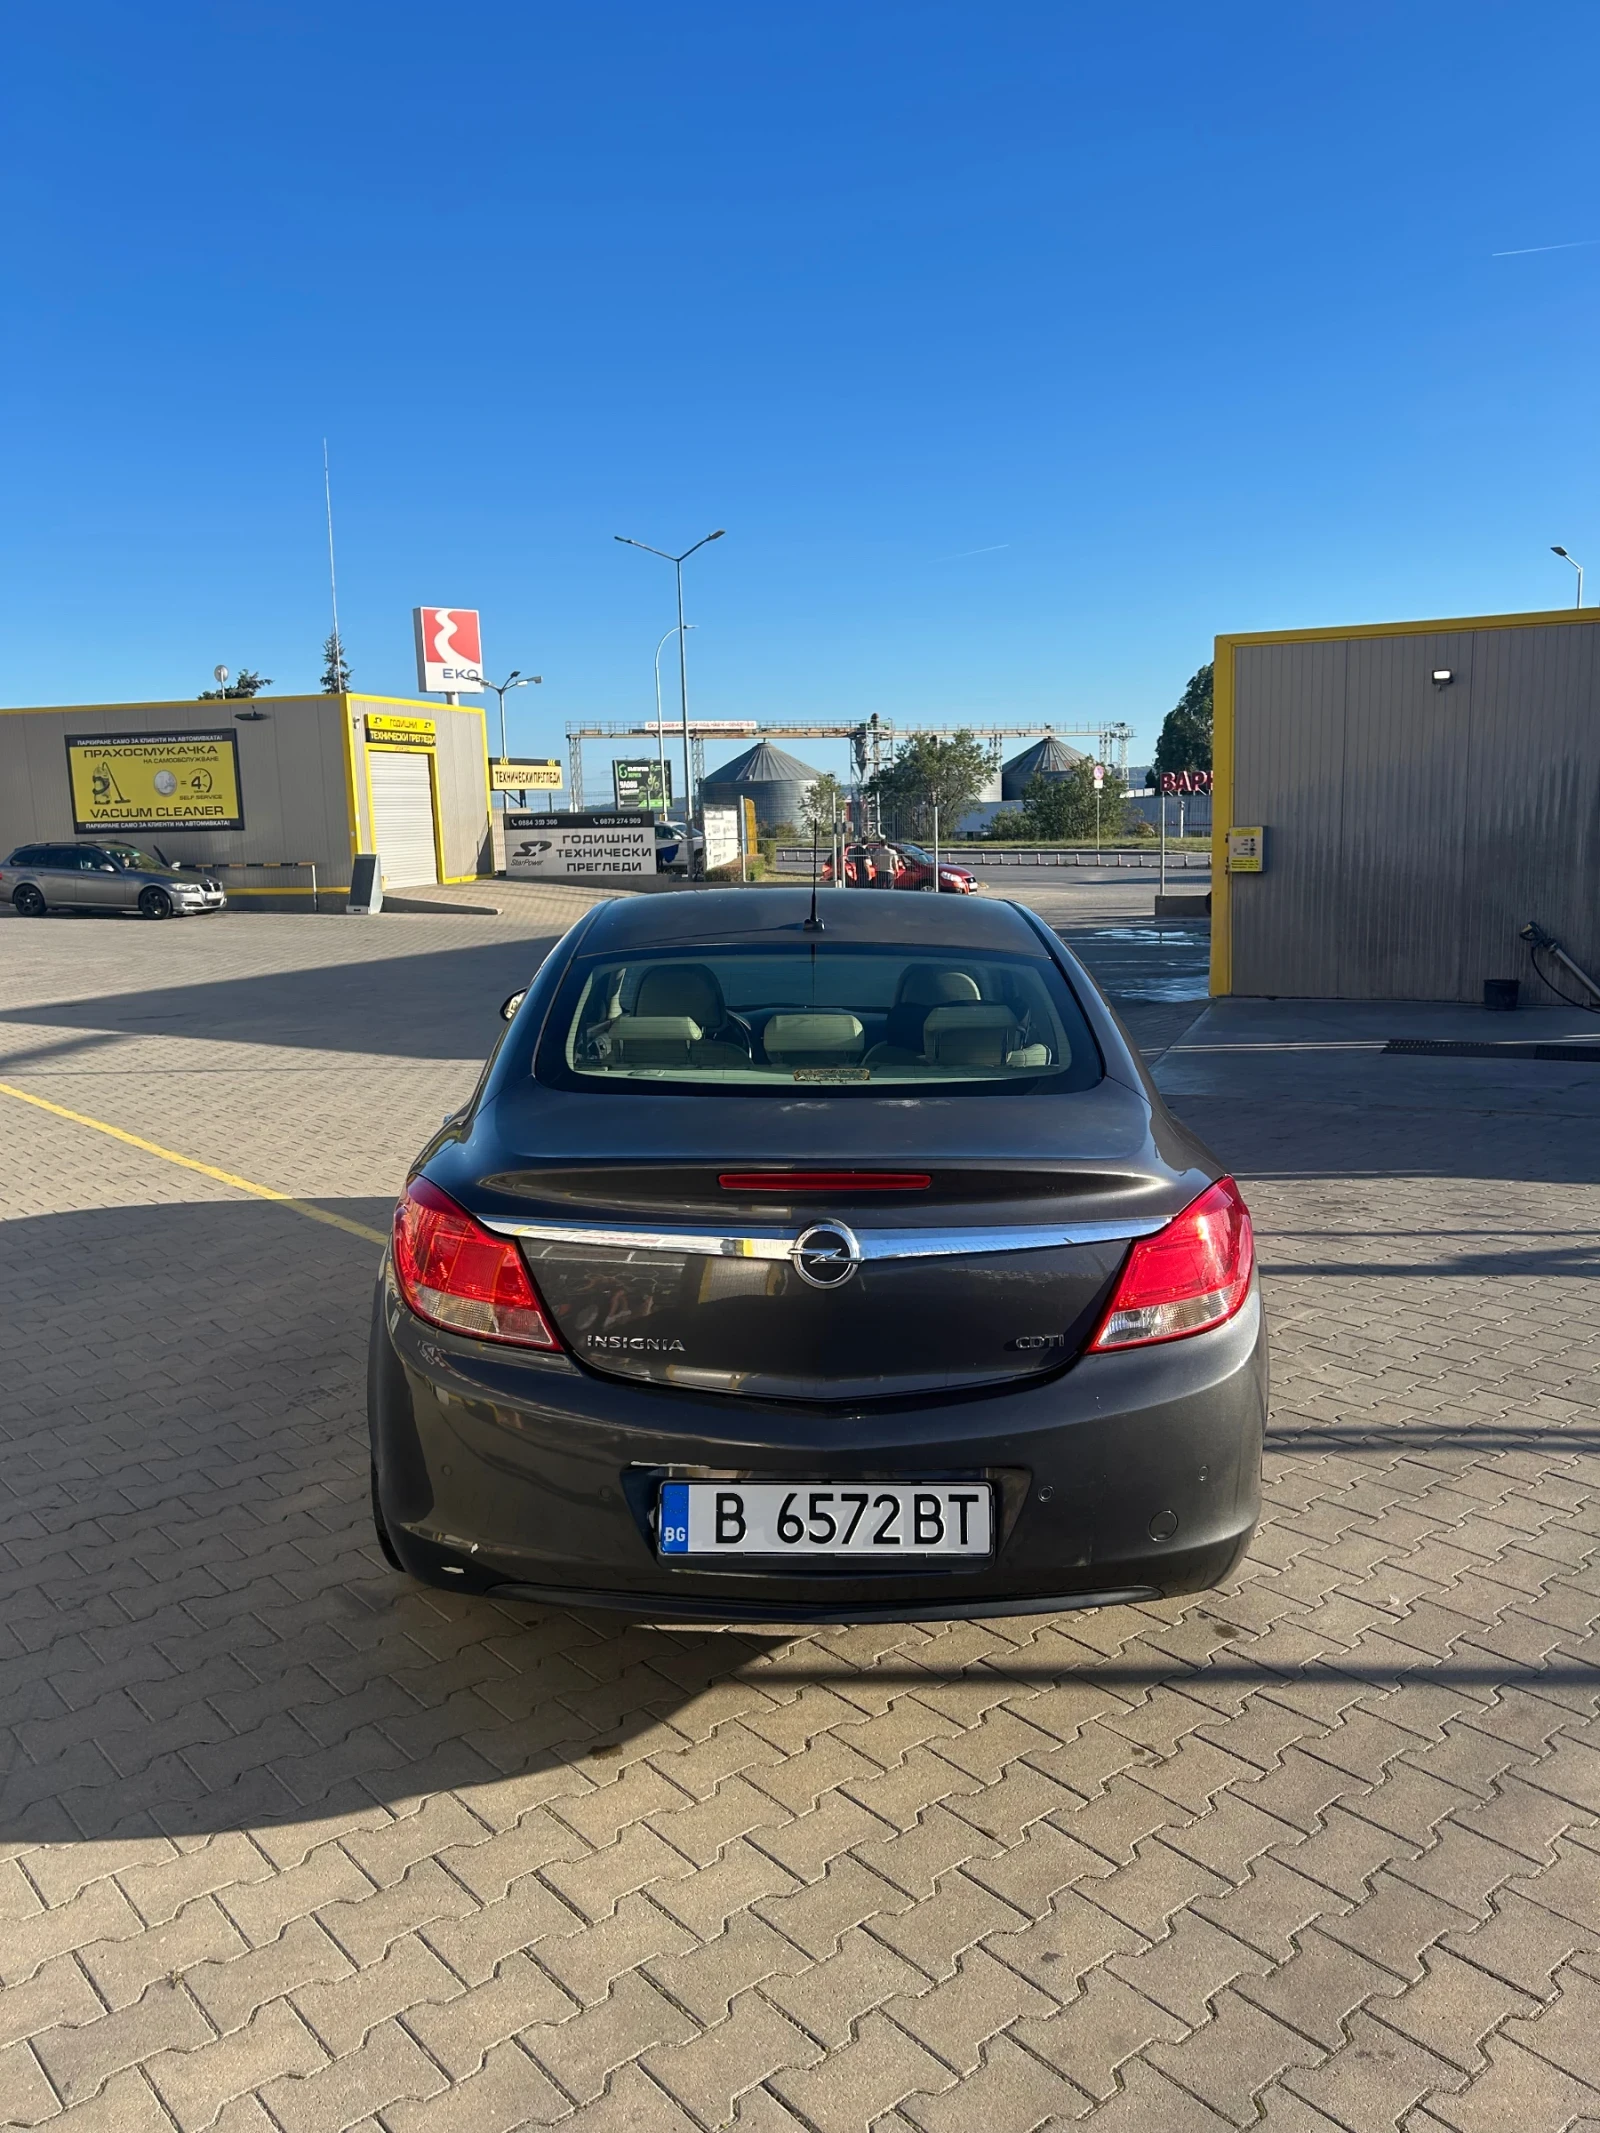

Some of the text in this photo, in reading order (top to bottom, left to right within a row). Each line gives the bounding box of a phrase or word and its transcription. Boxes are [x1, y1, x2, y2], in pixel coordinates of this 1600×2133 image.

[442, 668, 478, 679] EKO
[140, 736, 166, 744] КЛИЕНТИ
[370, 730, 408, 742] ТЕХНИЧЕСКИ
[84, 746, 218, 758] ПРАХОСМУКАЧКА
[191, 776, 202, 789] 4
[90, 806, 224, 818] VACUUM CLEANER
[562, 834, 643, 844] ГОДИШНИ
[556, 848, 652, 858] ТЕХНИЧЕСКИ
[567, 862, 642, 872] ПРЕГЛЕДИ
[587, 1335, 686, 1352] INSIGNIA
[1016, 1334, 1065, 1349] CDTI
[715, 1493, 748, 1544] B
[664, 1527, 686, 1542] BG
